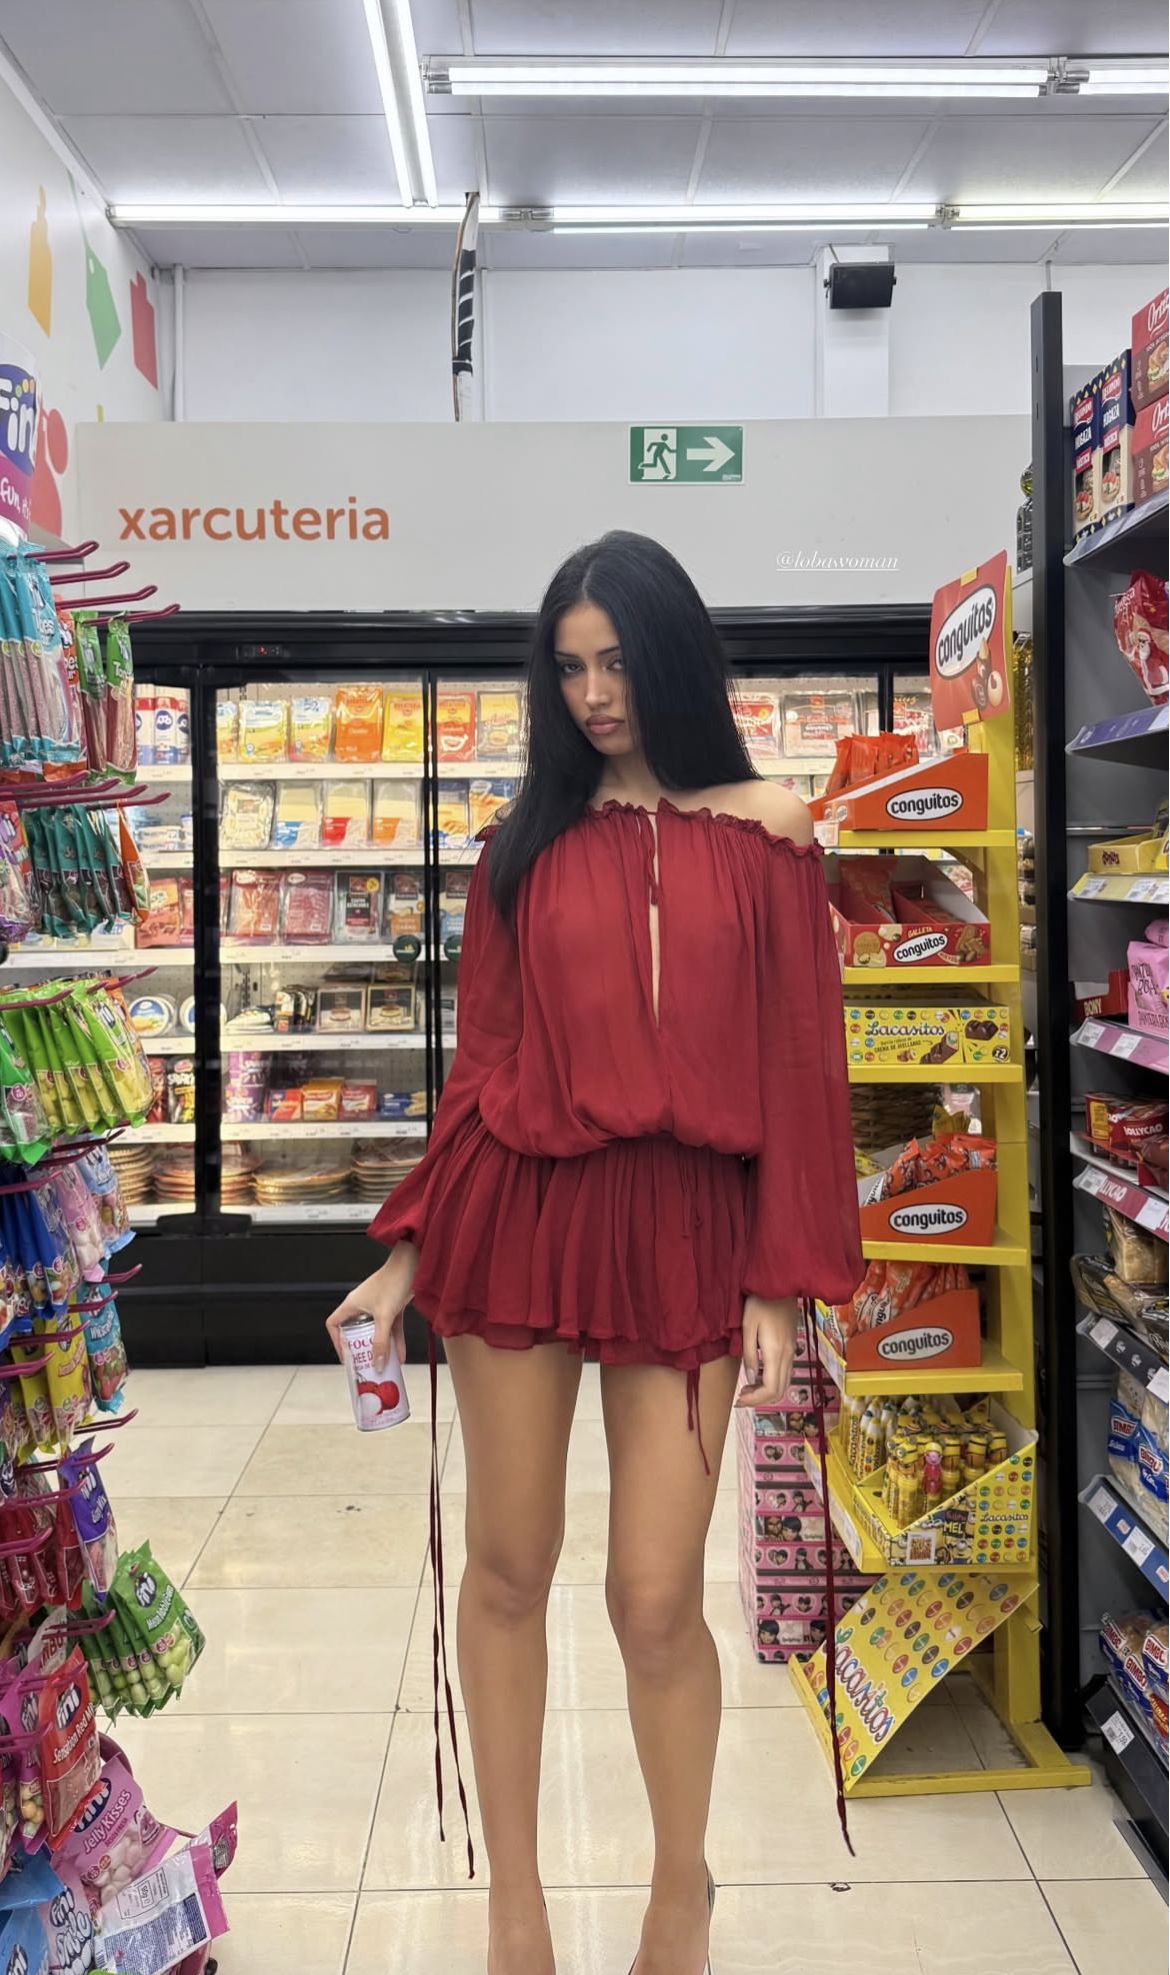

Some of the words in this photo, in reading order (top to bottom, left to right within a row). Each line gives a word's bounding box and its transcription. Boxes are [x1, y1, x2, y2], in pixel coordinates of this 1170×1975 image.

[1152, 402, 1169, 431] Ort
[118, 495, 390, 541] xarcuteria
[937, 596, 994, 668] conguitos
[890, 793, 959, 815] conguitos
[907, 926, 933, 937] GALLETA
[896, 934, 945, 959] conguitos
[865, 1021, 945, 1036] Lacasitos
[893, 1209, 964, 1229] conguitos
[882, 1332, 950, 1355] conguitos
[980, 1513, 1029, 1522] Lacasitos
[53, 1735, 78, 1764] Sensation
[75, 1717, 89, 1740] Red
[83, 1829, 108, 1854] Jelly
[102, 1789, 132, 1834] Kisses
